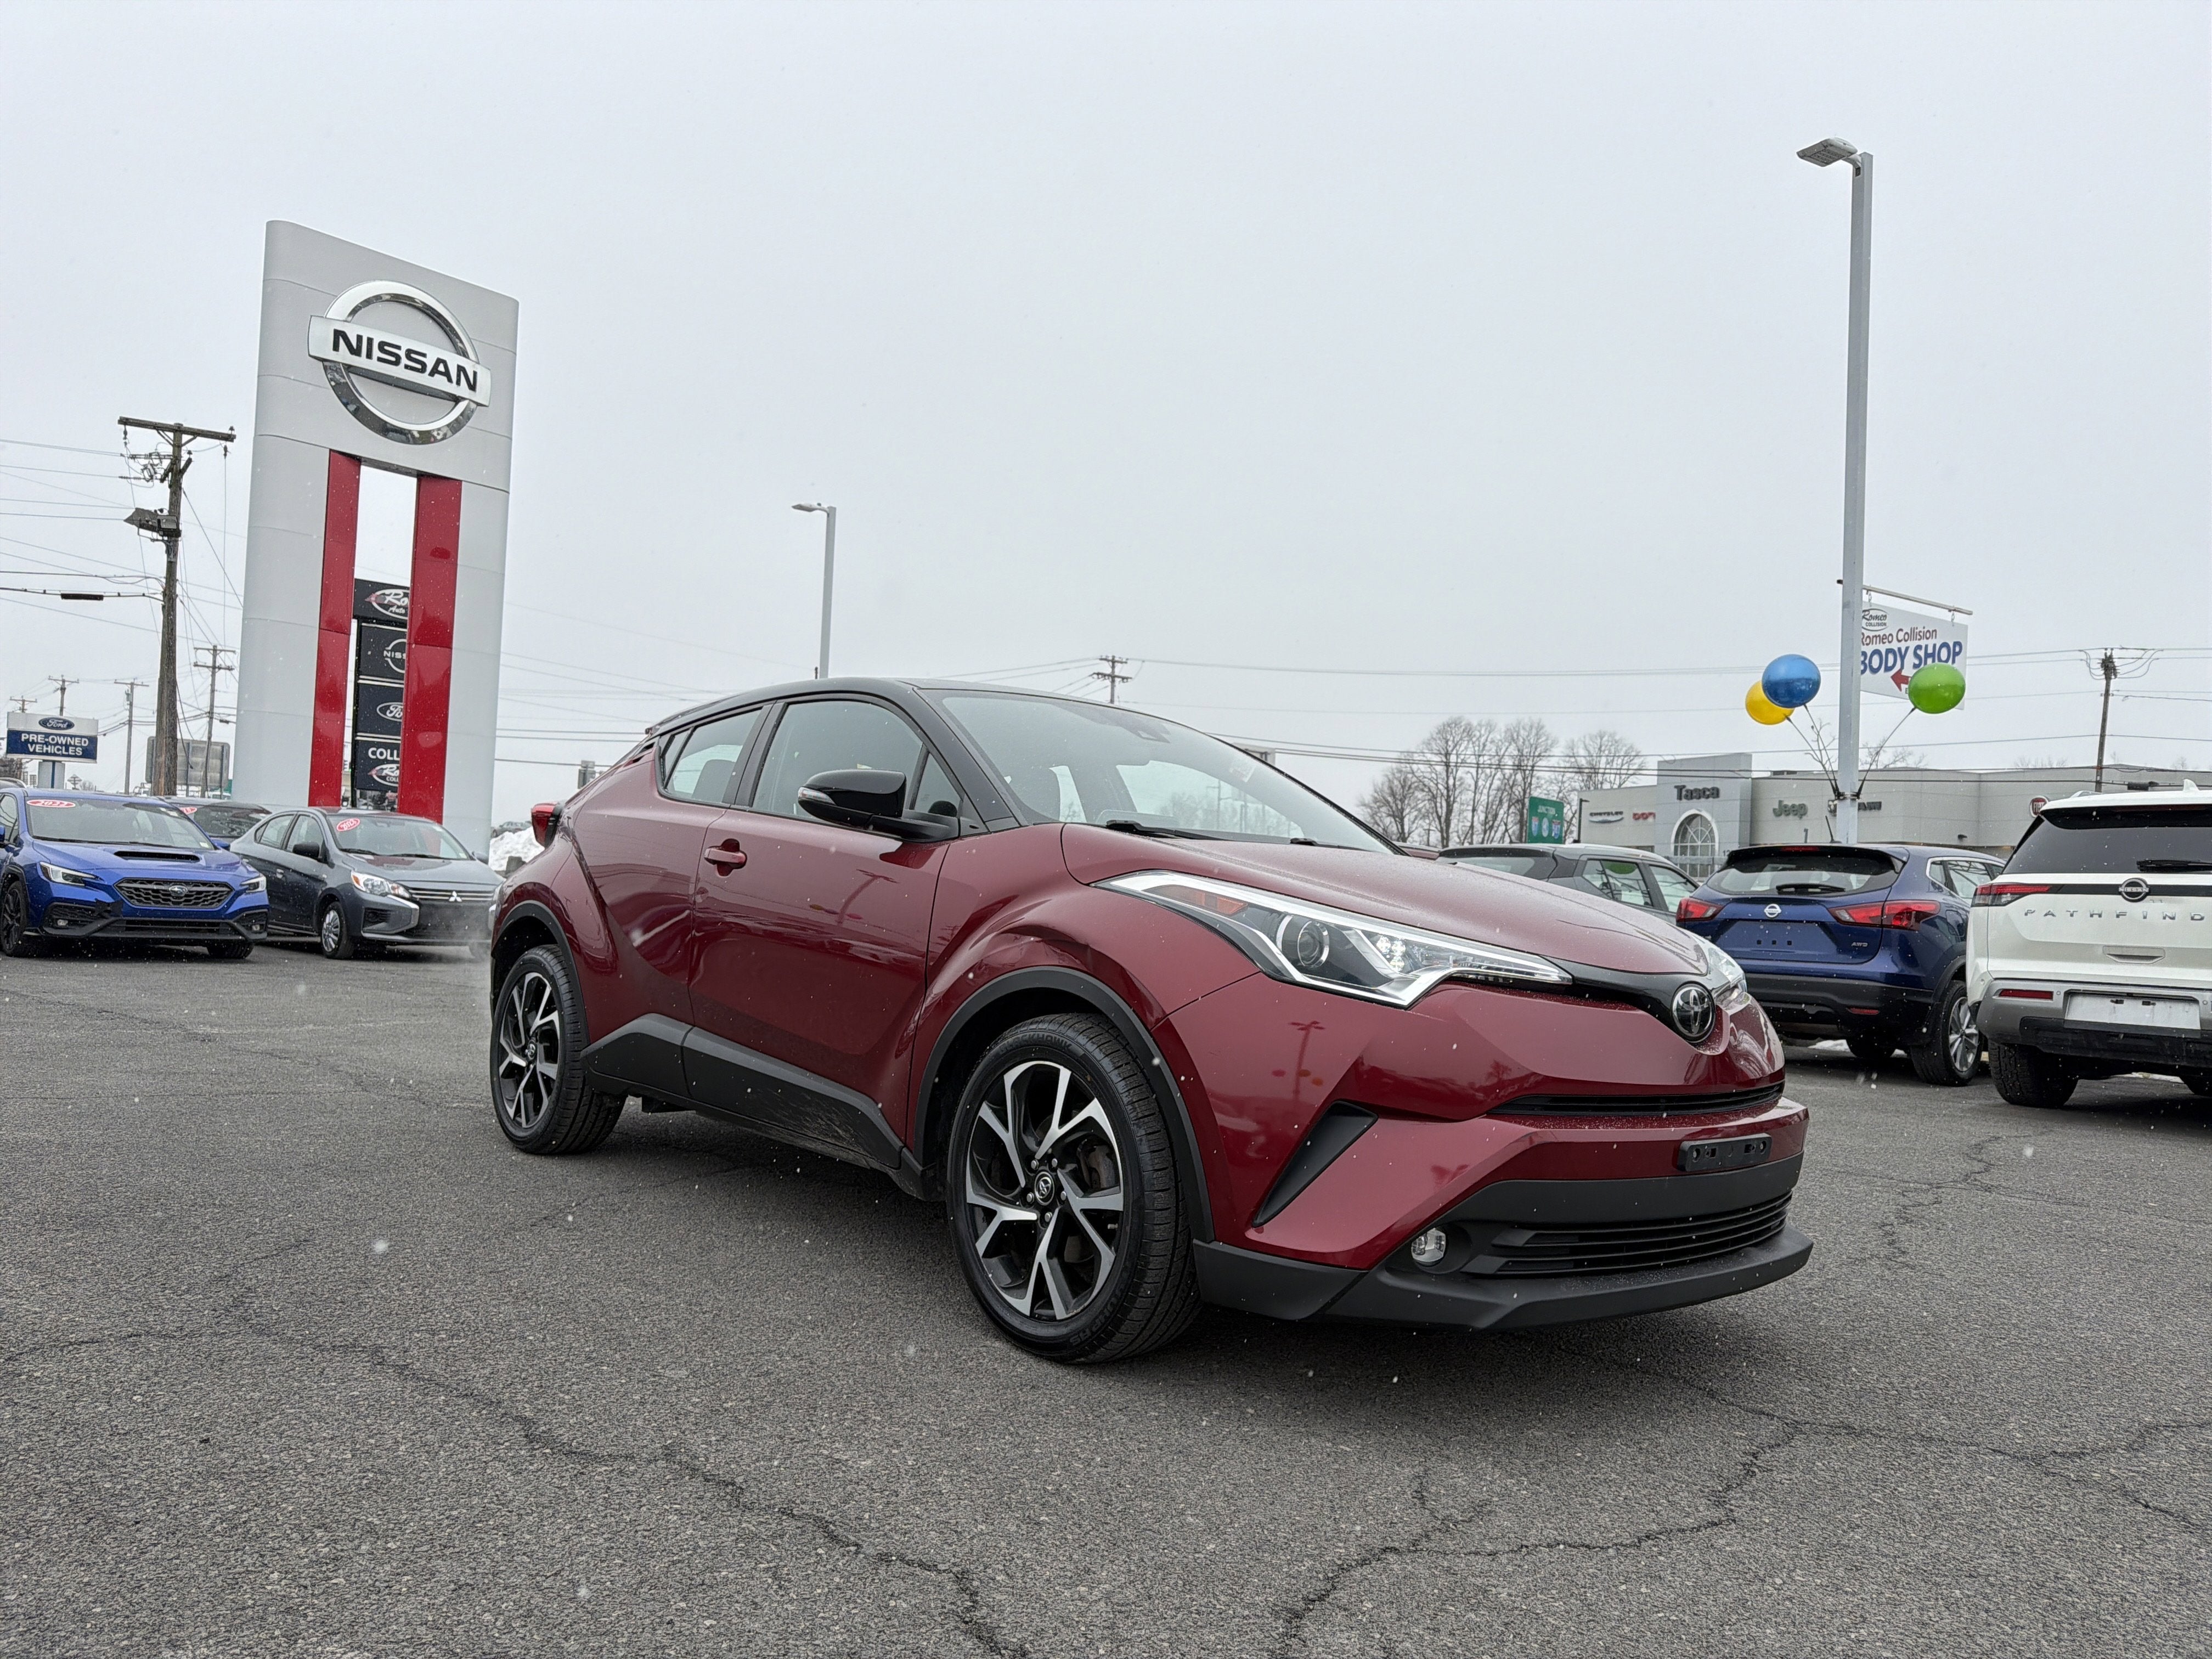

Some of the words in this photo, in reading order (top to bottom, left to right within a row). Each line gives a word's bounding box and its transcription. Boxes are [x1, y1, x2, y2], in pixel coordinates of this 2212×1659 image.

[332, 329, 477, 392] NISSAN
[388, 605, 405, 614] Auto
[1896, 627, 1937, 642] Collision
[1912, 641, 1963, 670] SHOP
[47, 719, 69, 729] Ford
[21, 733, 89, 747] PRE-OWNED
[27, 743, 83, 756] VEHICLES
[1674, 785, 1720, 801] Tasca
[1773, 800, 1808, 820] Jeep
[2024, 909, 2205, 921] PATHFIND
